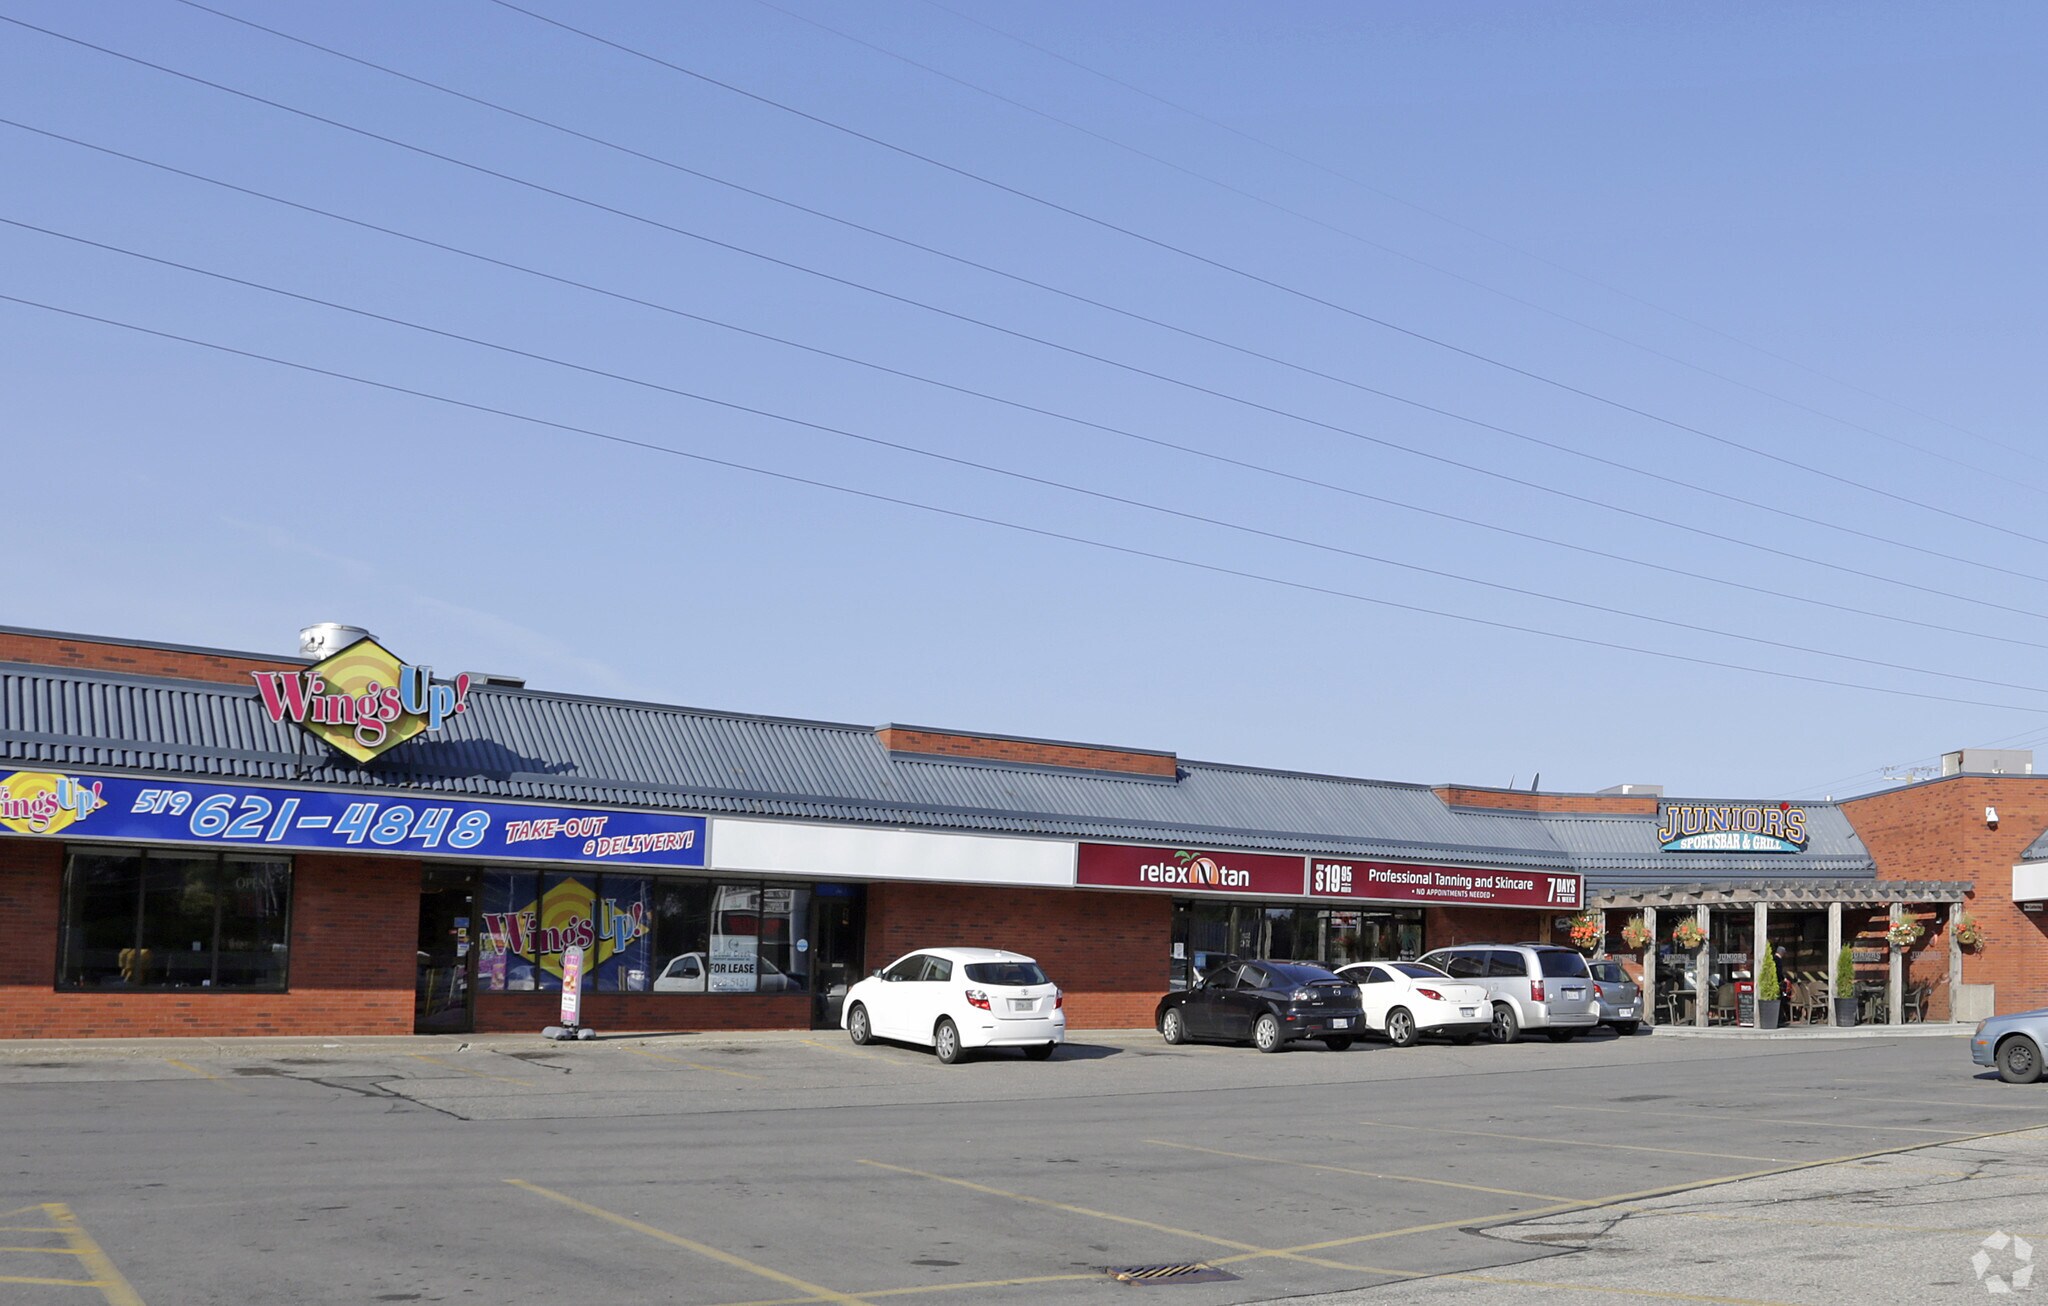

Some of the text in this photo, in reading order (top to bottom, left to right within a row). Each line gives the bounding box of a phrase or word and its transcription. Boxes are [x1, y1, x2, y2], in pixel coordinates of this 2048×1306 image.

[130, 788, 492, 849] 519 621-4848
[505, 816, 609, 844] TAKE-OUT
[582, 829, 695, 857] & DELIVERY!
[1680, 833, 1782, 850] SPORTSBAR & GRILL
[1140, 862, 1188, 884] relax
[1219, 865, 1250, 887] tan
[1369, 869, 1533, 890] Professional Tanning and Skincare
[1426, 889, 1468, 898] APPOINTMENTS
[1469, 891, 1490, 899] NEEDED
[1547, 877, 1576, 903] 7 DAYS
[710, 963, 754, 973] FOR LEASE
